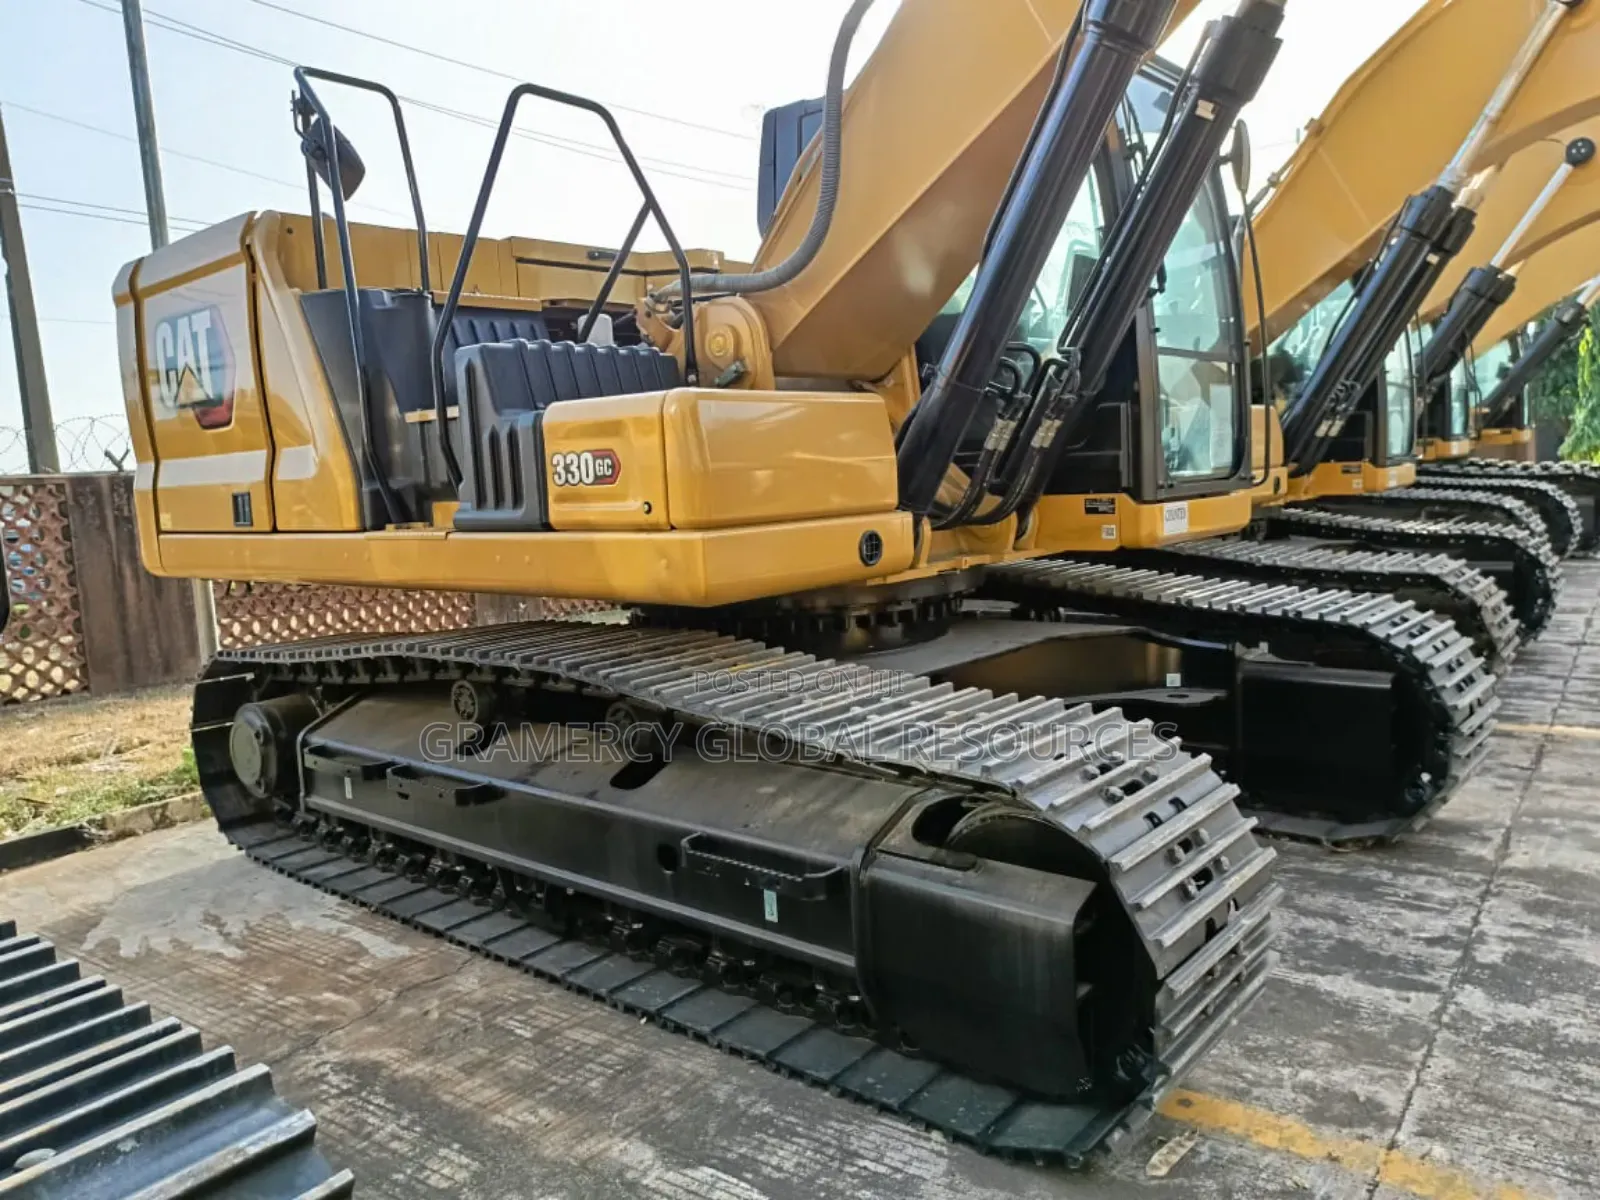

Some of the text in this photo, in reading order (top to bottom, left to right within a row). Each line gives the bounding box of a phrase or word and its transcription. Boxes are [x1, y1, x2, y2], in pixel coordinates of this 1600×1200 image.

[155, 310, 213, 410] CAT
[552, 452, 612, 486] 330 GC
